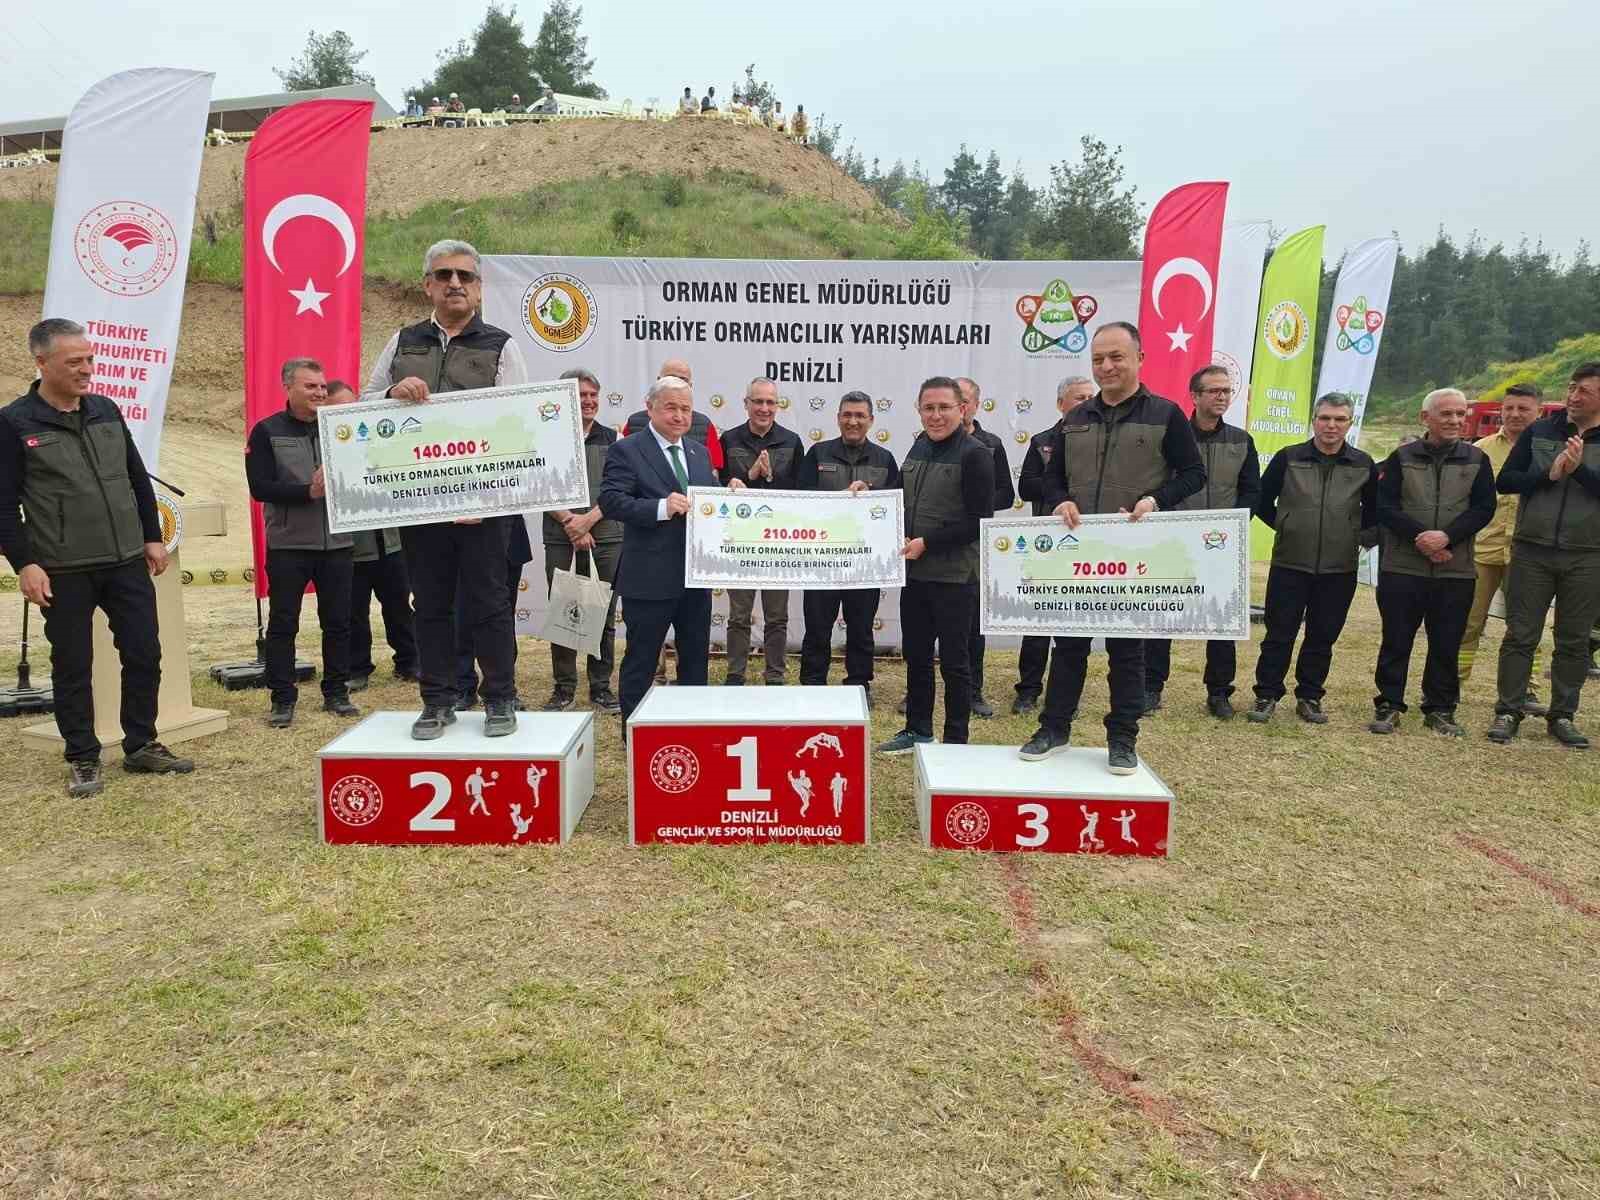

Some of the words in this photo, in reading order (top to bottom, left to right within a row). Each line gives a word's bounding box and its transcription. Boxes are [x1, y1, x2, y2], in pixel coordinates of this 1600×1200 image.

[662, 281, 737, 303] ORMAN
[745, 282, 810, 305] GENEL
[817, 277, 951, 306] MÜDÜRLÜĞÜ
[88, 319, 148, 342] TÜRKİYE
[622, 315, 707, 342] TÜRKİYE
[714, 322, 844, 345] ORMANCILIK
[850, 324, 991, 350] YARIŞMALARI
[89, 341, 168, 364] MHURİYETİ
[130, 366, 147, 381] VE
[766, 356, 843, 384] DENİZLİ
[413, 440, 476, 459] 140.000
[408, 463, 474, 480] ORMANCILIK
[763, 528, 817, 540] 210.000
[1072, 562, 1127, 576] 70.000
[1060, 585, 1127, 595] ORMANCILIK
[726, 736, 772, 801] 1
[409, 771, 455, 831] 2
[720, 808, 779, 824] DENİZLİ
[1015, 803, 1050, 847] 3
[657, 826, 705, 839] GENÇLİK
[707, 827, 722, 837] VE
[723, 826, 754, 837] SPOR
[756, 824, 766, 836] İL
[768, 824, 842, 838] MÜDÜRLÜĞÜ
